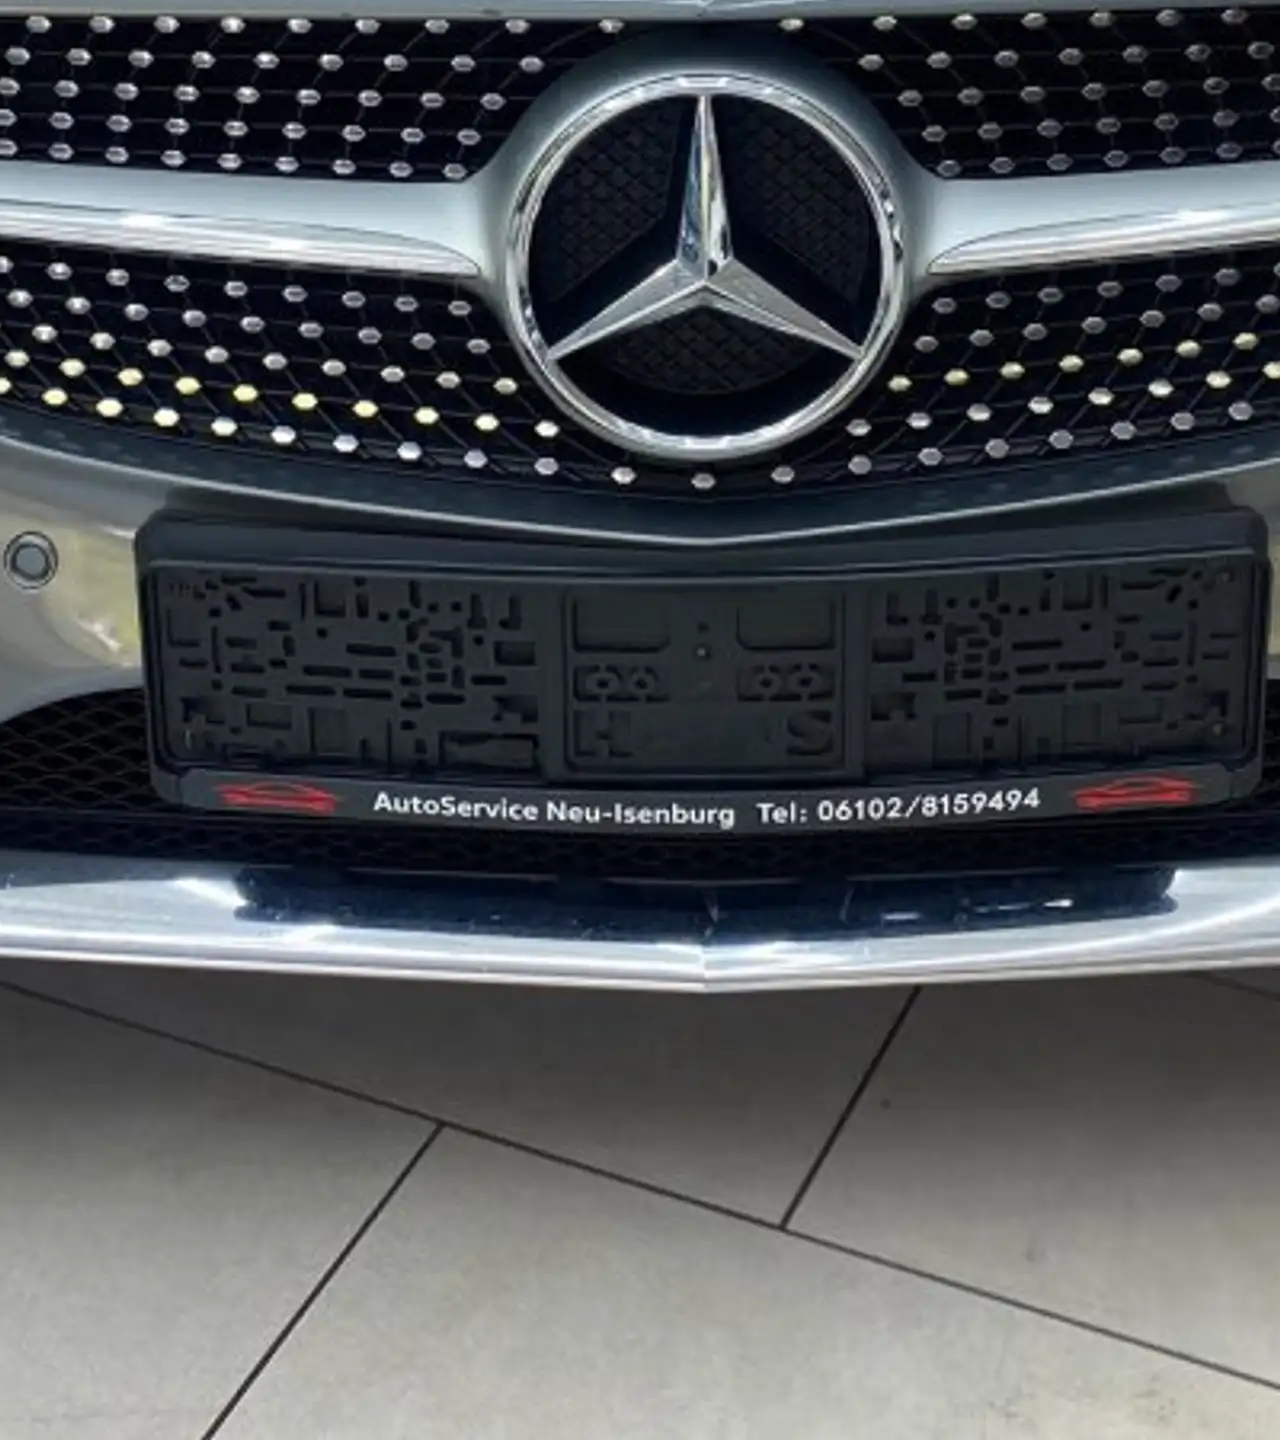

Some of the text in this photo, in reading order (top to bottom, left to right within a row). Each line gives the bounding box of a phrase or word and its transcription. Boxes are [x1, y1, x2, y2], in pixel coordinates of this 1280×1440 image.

[373, 787, 1041, 830] AutoService Neu-Isenburg Tel: 06102/8159494
